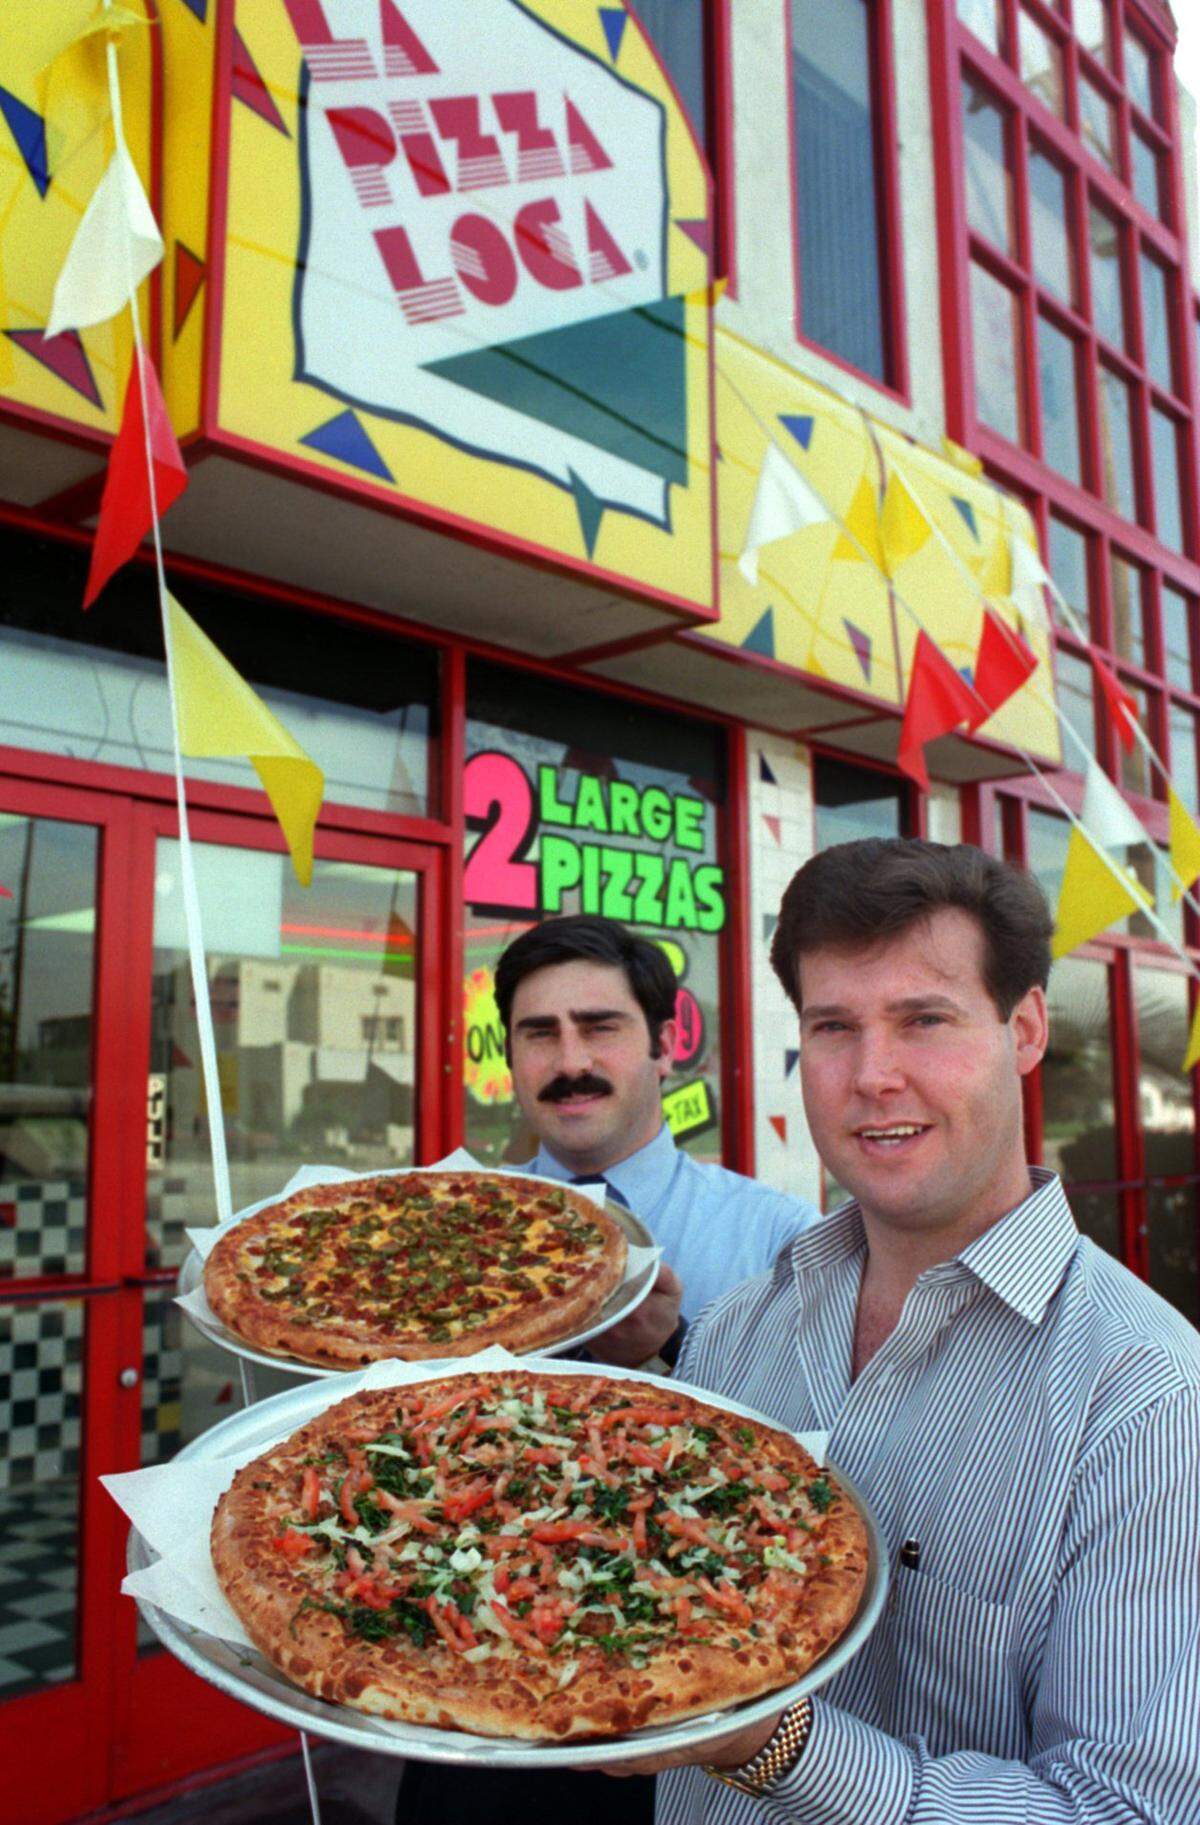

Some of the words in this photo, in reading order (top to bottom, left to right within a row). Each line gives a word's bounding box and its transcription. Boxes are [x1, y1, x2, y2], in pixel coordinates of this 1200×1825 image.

[283, 0, 441, 82] LA
[324, 90, 615, 208] PIZZA
[372, 196, 634, 325] LOCA
[463, 752, 539, 911] 2
[540, 765, 705, 852] LARGE
[541, 834, 726, 934] PIZZAS
